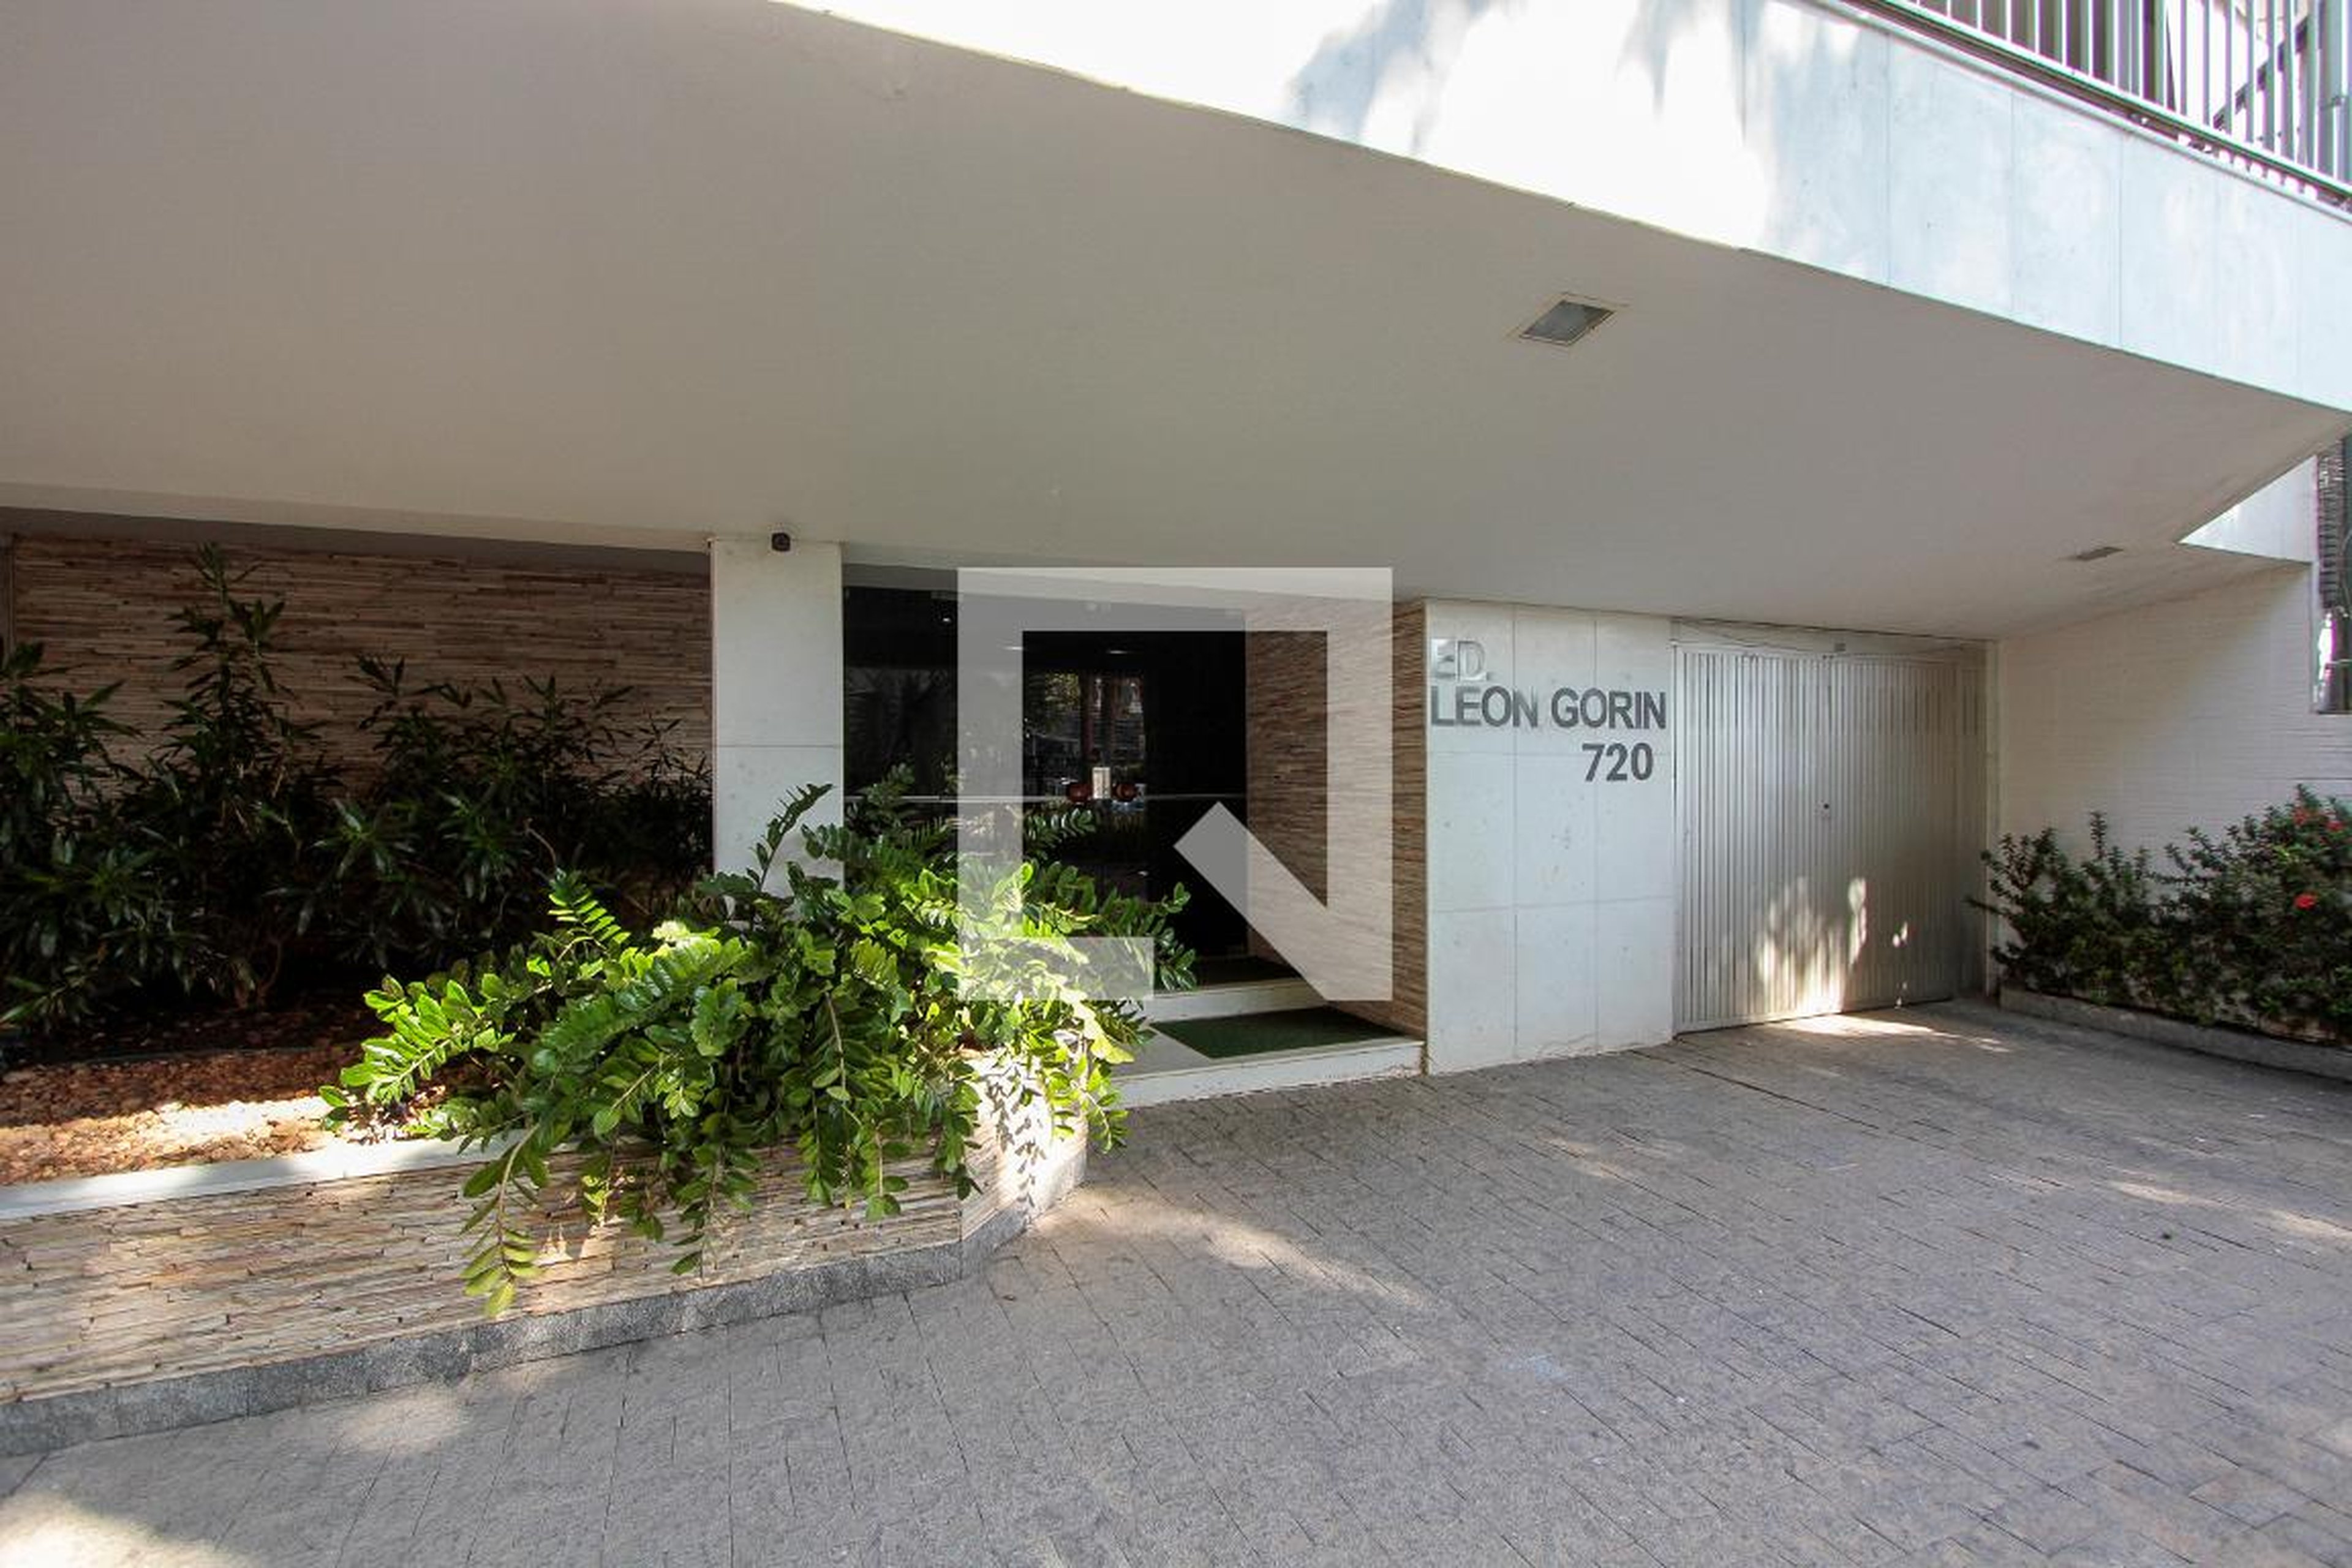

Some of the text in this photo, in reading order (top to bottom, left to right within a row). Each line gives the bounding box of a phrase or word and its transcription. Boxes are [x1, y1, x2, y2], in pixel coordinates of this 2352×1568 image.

[1431, 685, 1667, 729] LEON GORIN
[1581, 742, 1654, 782] 720
